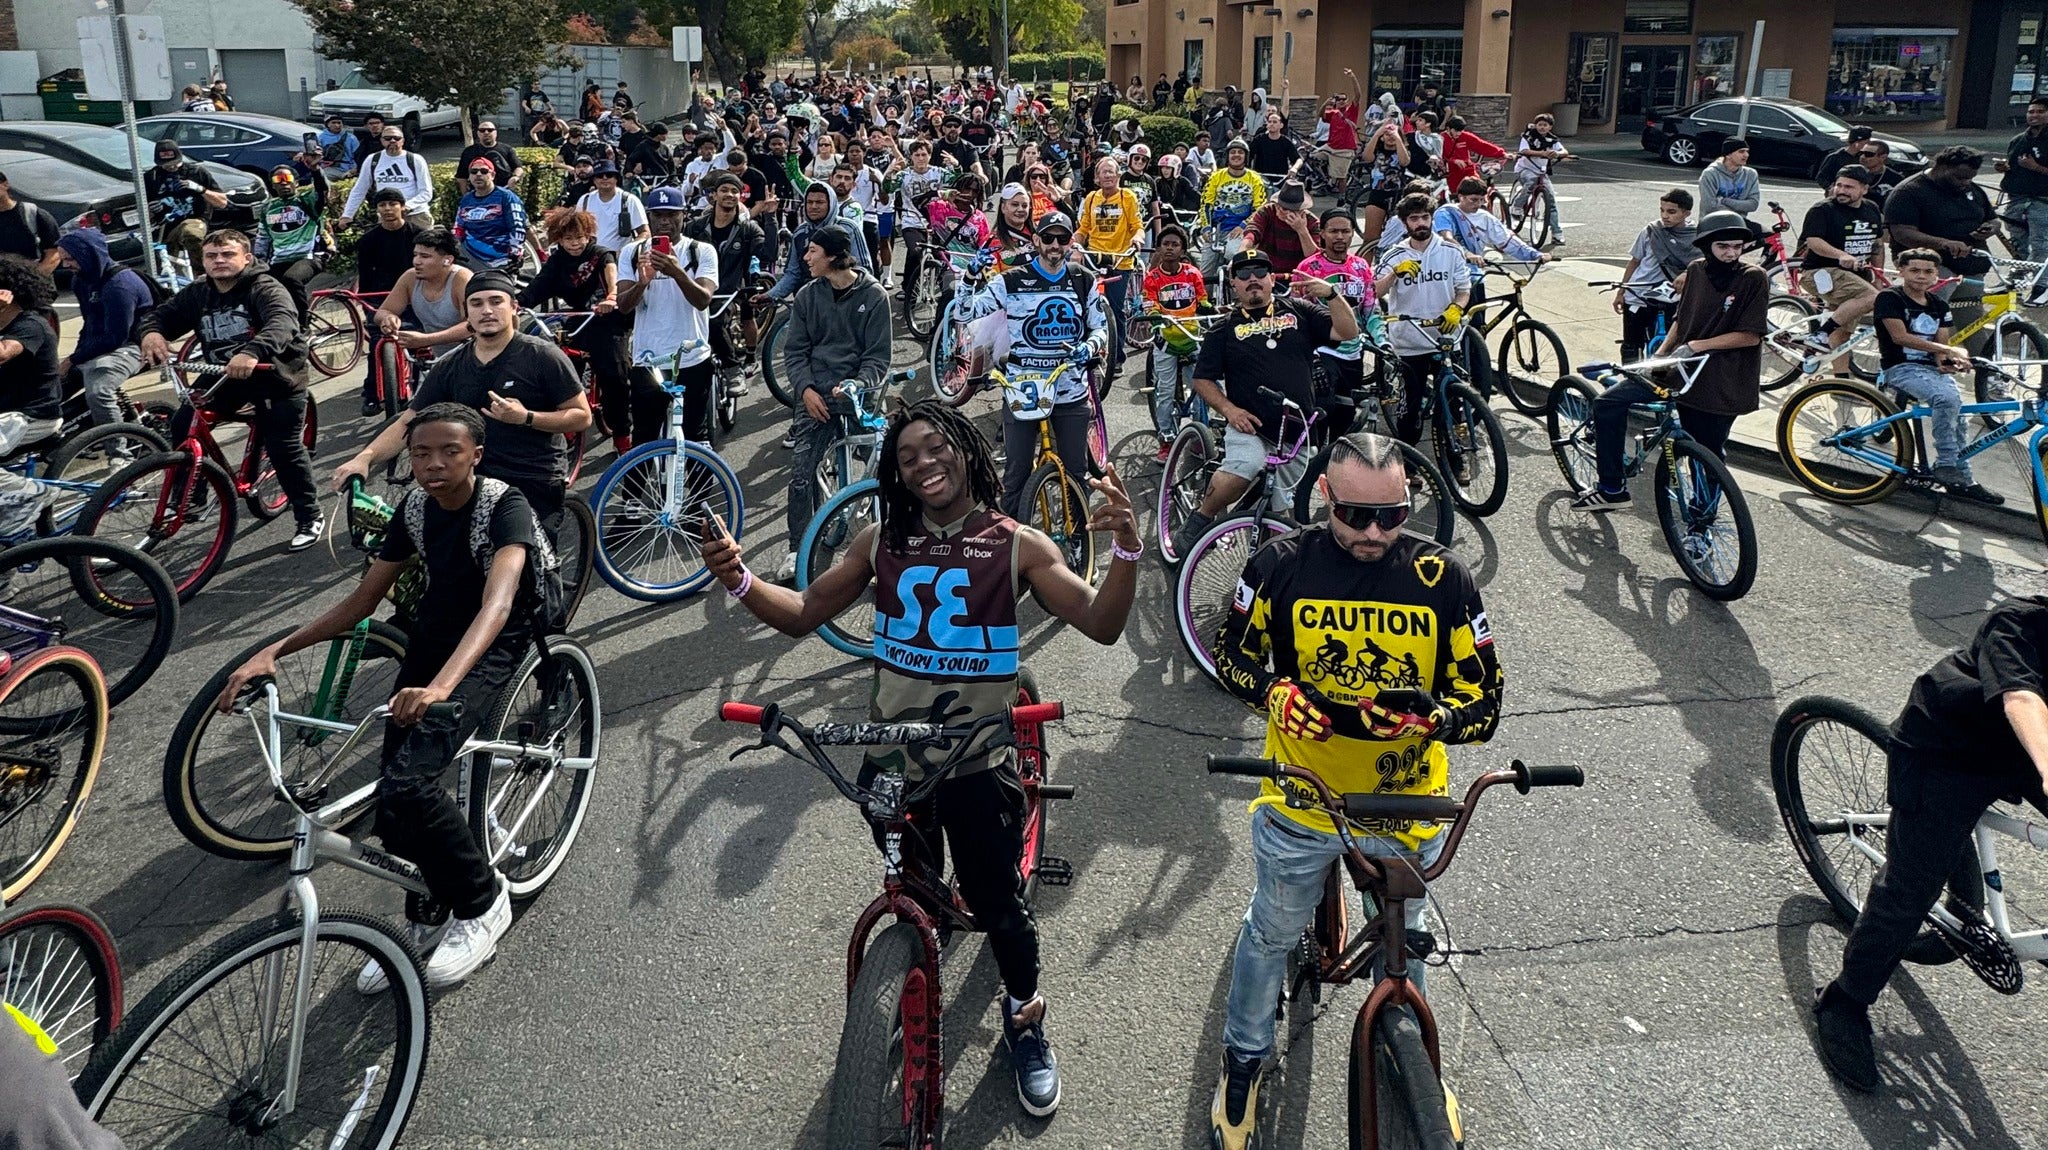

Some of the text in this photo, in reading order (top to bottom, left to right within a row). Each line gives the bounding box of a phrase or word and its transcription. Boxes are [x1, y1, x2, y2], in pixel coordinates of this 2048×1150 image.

[1246, 249, 1257, 260] P
[1040, 304, 1072, 324] SE
[1036, 326, 1077, 337] RACING
[1021, 358, 1062, 368] FACTORY
[1020, 381, 1039, 411] 3
[974, 549, 992, 558] box
[1299, 605, 1431, 637] CAUTION
[937, 656, 990, 673] SQUAD
